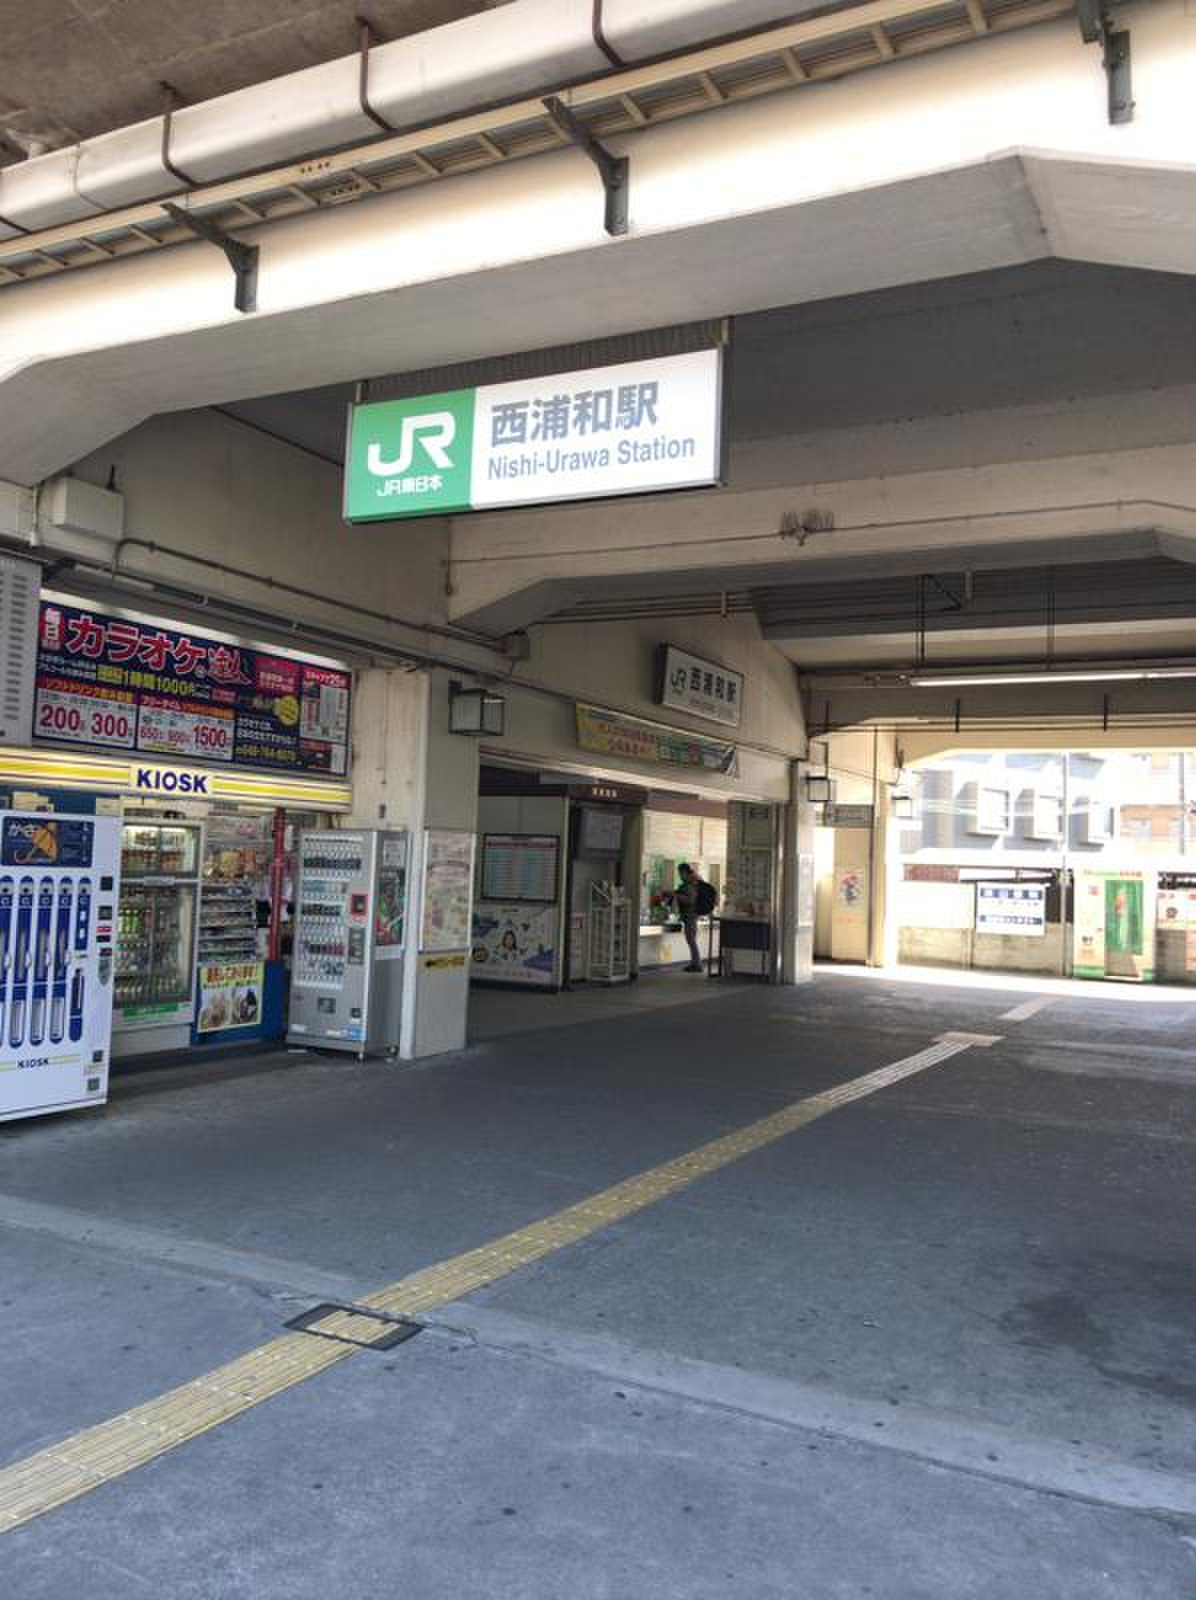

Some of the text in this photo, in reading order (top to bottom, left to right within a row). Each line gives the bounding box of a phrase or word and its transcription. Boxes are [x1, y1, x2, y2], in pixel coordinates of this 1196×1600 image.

[491, 382, 660, 448] 西浦和駅
[367, 411, 456, 476] JR
[487, 436, 696, 480] Nishi-Urawa Station
[376, 474, 443, 497] JR東日本
[65, 614, 206, 675] カラオケ
[137, 768, 209, 794] KIOSK
[17, 1057, 49, 1069] KIOSK
